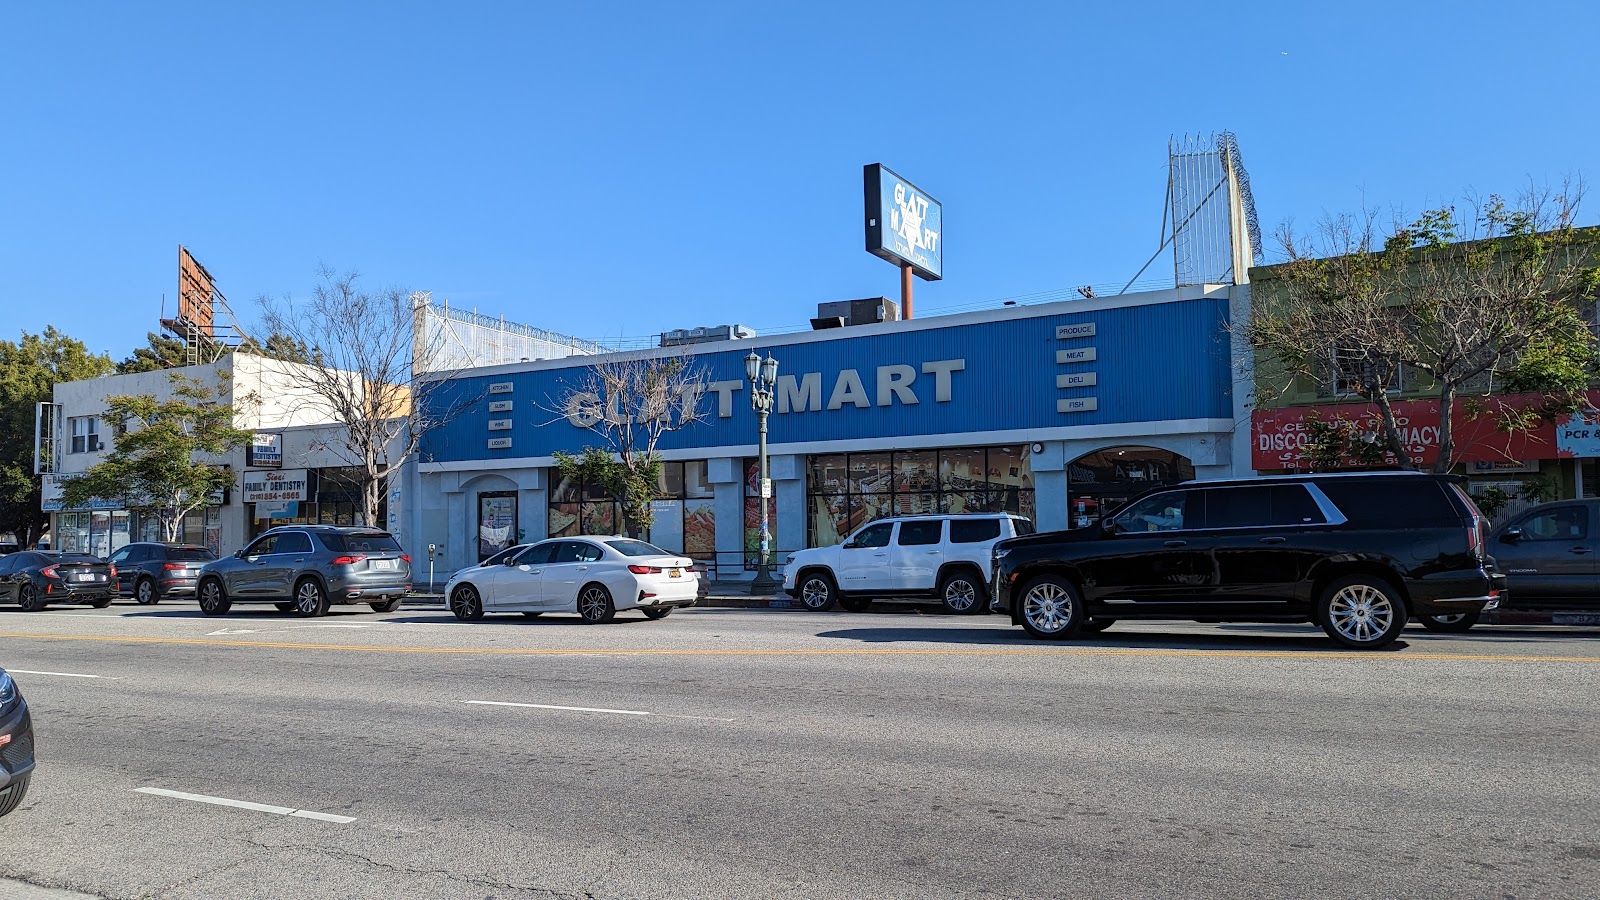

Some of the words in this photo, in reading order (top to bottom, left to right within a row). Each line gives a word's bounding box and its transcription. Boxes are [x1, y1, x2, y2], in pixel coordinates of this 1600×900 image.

[894, 183, 928, 220] GLATT
[890, 208, 938, 252] MART
[1058, 325, 1092, 335] PRODUCE
[1066, 351, 1085, 359] MEAT
[1068, 376, 1084, 384] DELI
[777, 358, 965, 414] MART
[1565, 430, 1590, 439] PCR
[1280, 461, 1302, 469] Tel.
[245, 482, 267, 492] FAMILY
[270, 480, 306, 491] DENTISTRY
